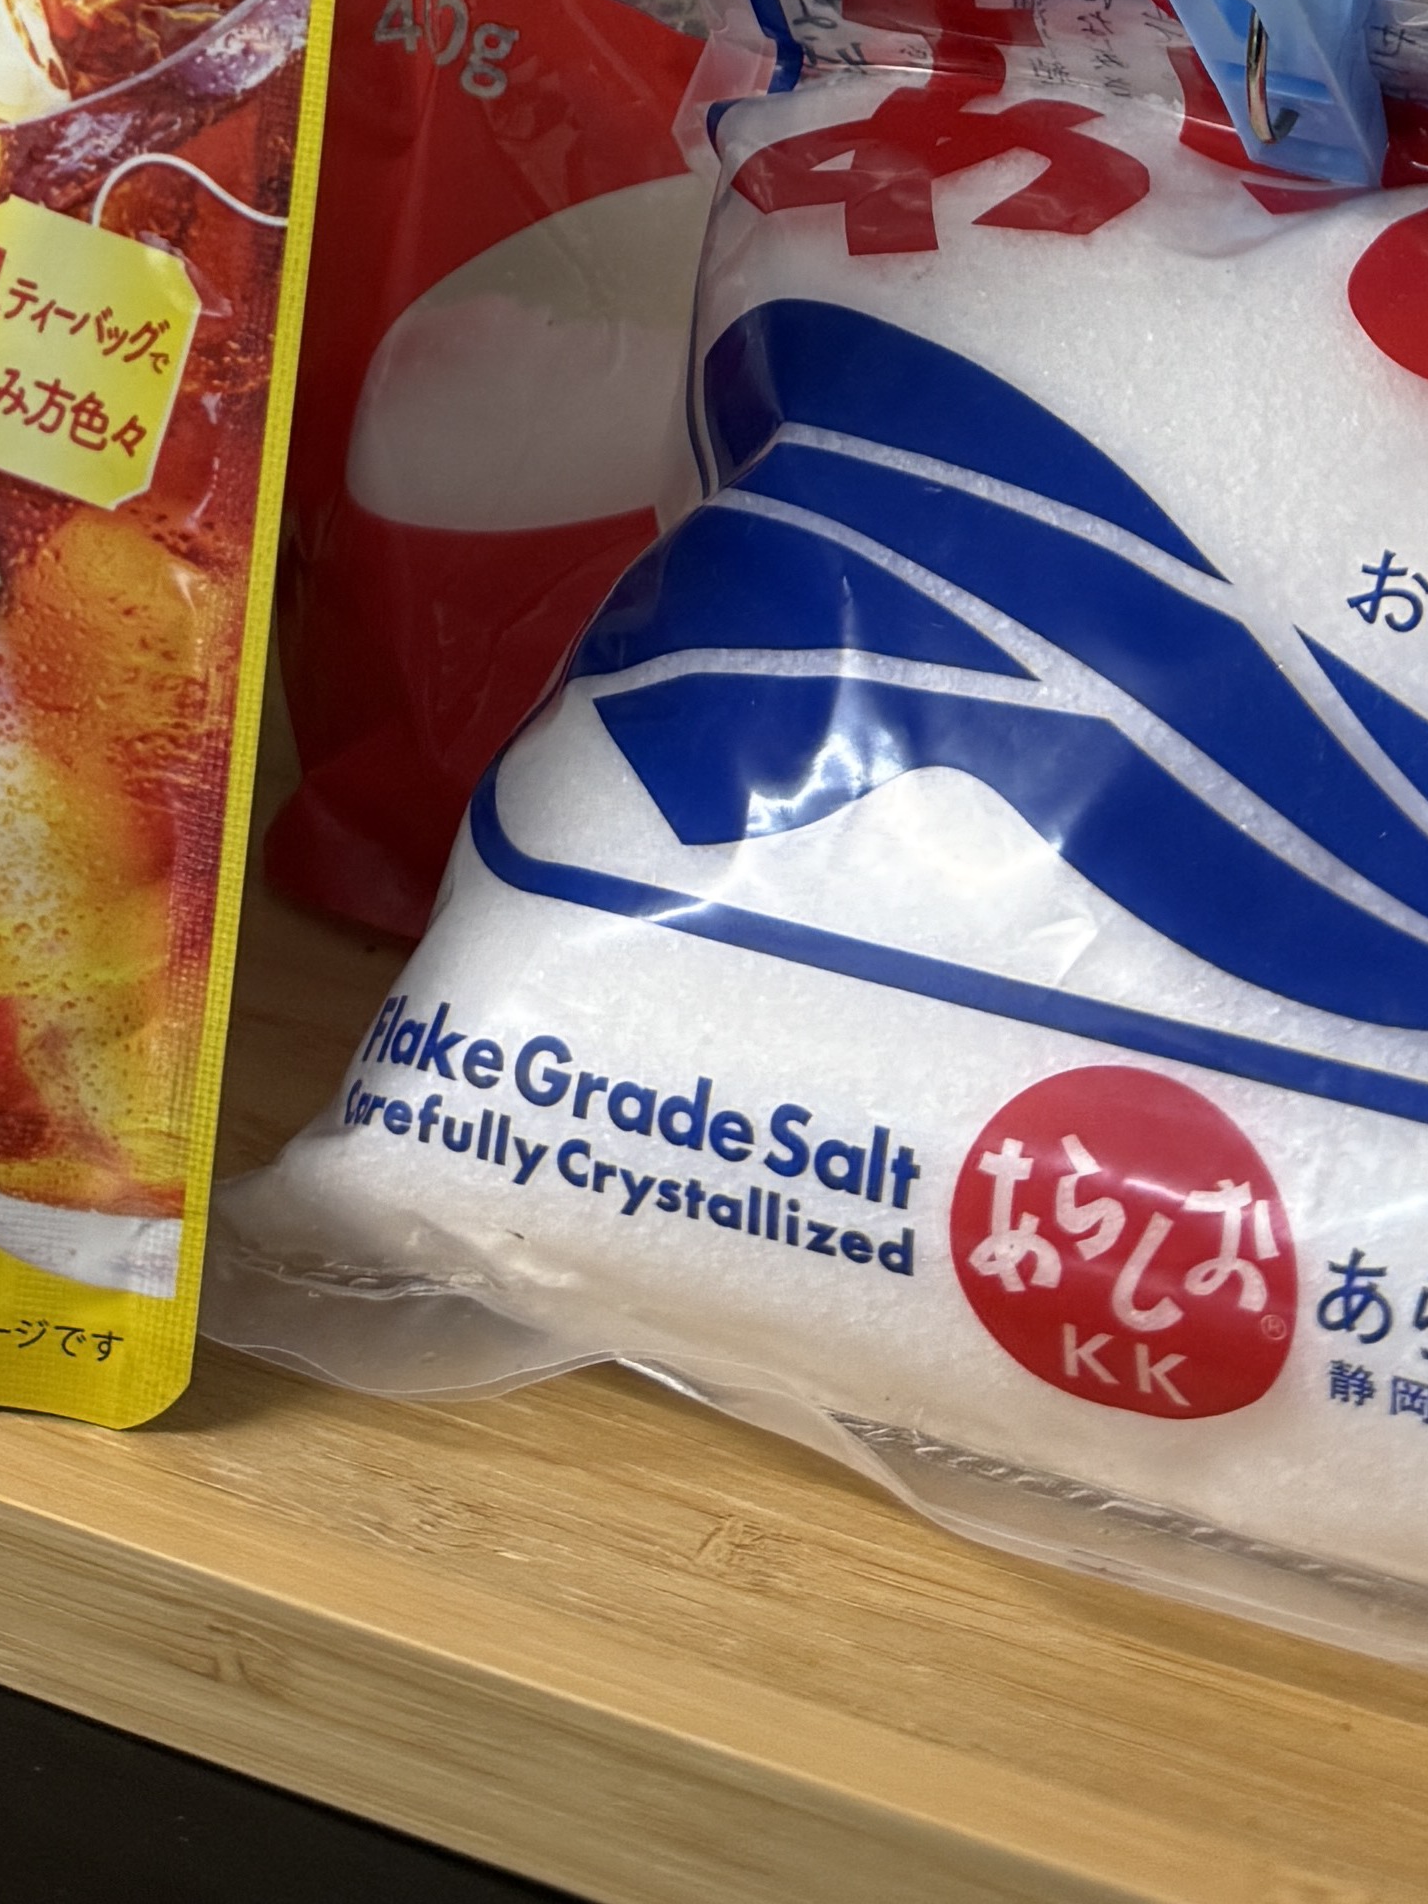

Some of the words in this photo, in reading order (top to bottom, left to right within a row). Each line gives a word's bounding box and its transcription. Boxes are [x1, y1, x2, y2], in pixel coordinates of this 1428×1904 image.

[344, 1079, 550, 1185] Carefully
[558, 1140, 915, 1277] Crystallized
[364, 996, 505, 1090] Flake
[515, 1035, 757, 1163] Grade
[765, 1104, 921, 1209] Salt
[969, 1134, 1280, 1332] あらしお
